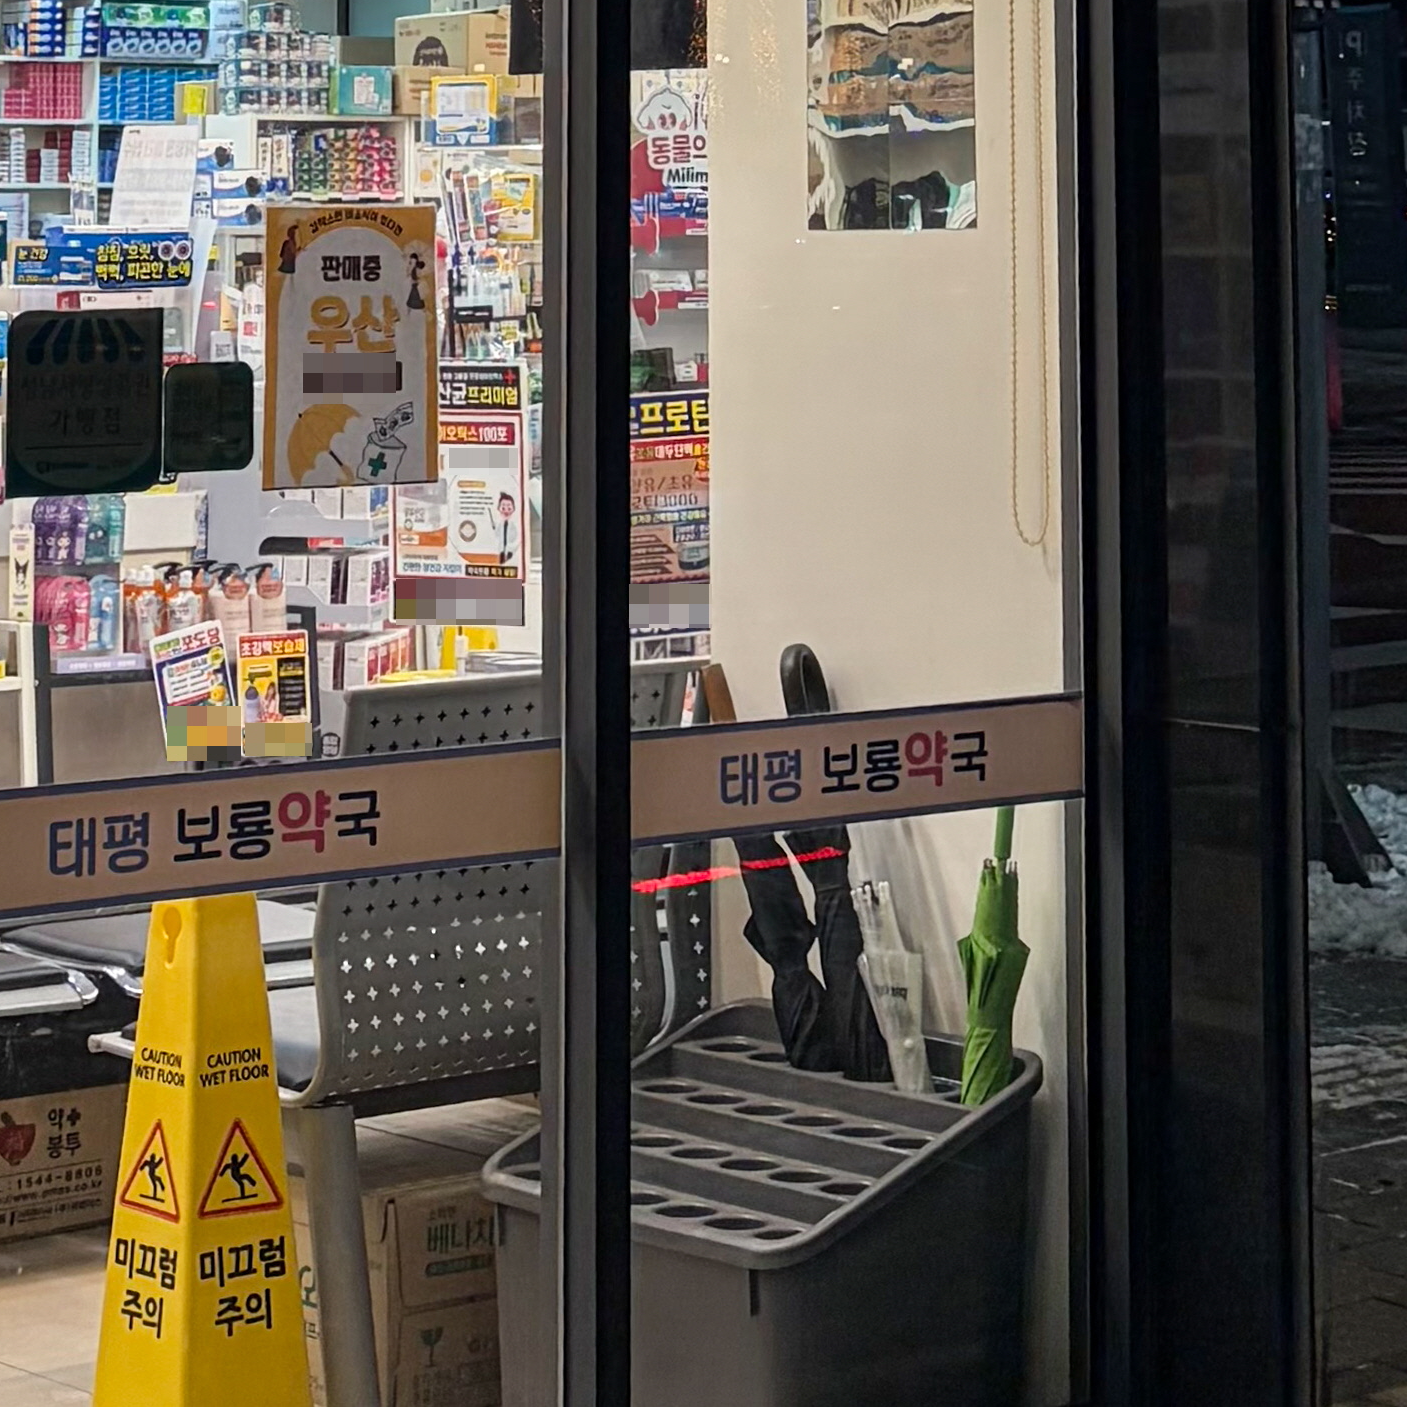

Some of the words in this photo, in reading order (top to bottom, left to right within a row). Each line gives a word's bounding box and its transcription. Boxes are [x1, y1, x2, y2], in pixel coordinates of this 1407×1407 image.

[128, 262, 164, 281] 피곤한
[321, 255, 382, 282] 판매중
[307, 293, 400, 354] 우산
[181, 627, 222, 652] 포도당
[719, 747, 803, 806] 태평
[821, 729, 989, 795] 보룡약국
[49, 809, 152, 878] 태평
[173, 788, 383, 862] 보룡약국
[140, 1046, 183, 1069] CAUTION
[206, 1047, 262, 1069] CAUTION
[133, 1062, 157, 1084] WET
[157, 1067, 185, 1088] FLOOR
[199, 1070, 227, 1089] WET
[229, 1063, 270, 1083] FLOOR
[46, 1132, 81, 1159] 봉투
[115, 1237, 178, 1292] 미끄럼
[199, 1235, 287, 1288] 미끄럼
[120, 1291, 164, 1339] 주의
[214, 1288, 273, 1338] 주의
